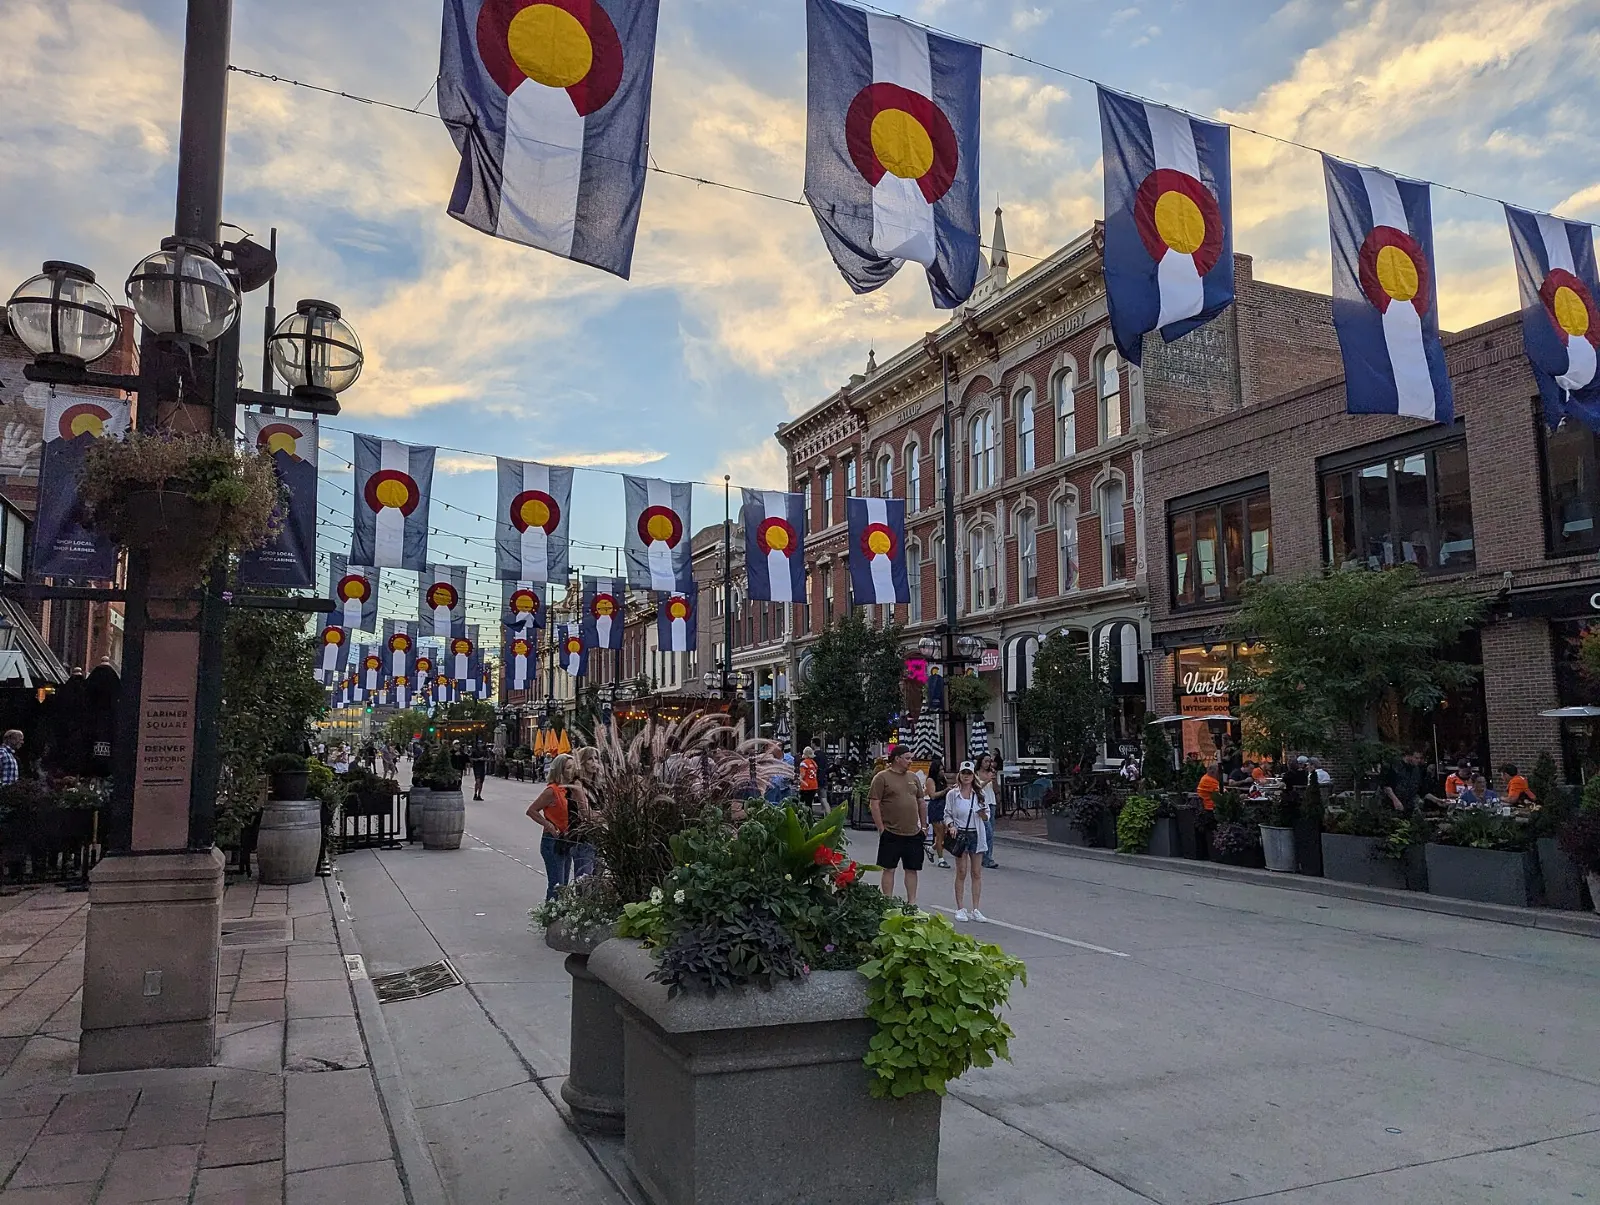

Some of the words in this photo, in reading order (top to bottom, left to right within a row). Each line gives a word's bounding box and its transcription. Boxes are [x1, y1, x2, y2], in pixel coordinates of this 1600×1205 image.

[1036, 311, 1086, 350] STANBURY
[898, 403, 921, 423] GALLUP
[146, 710, 188, 718] LARIMER
[146, 721, 188, 730] SQUARE
[144, 755, 186, 763] HISTORIC
